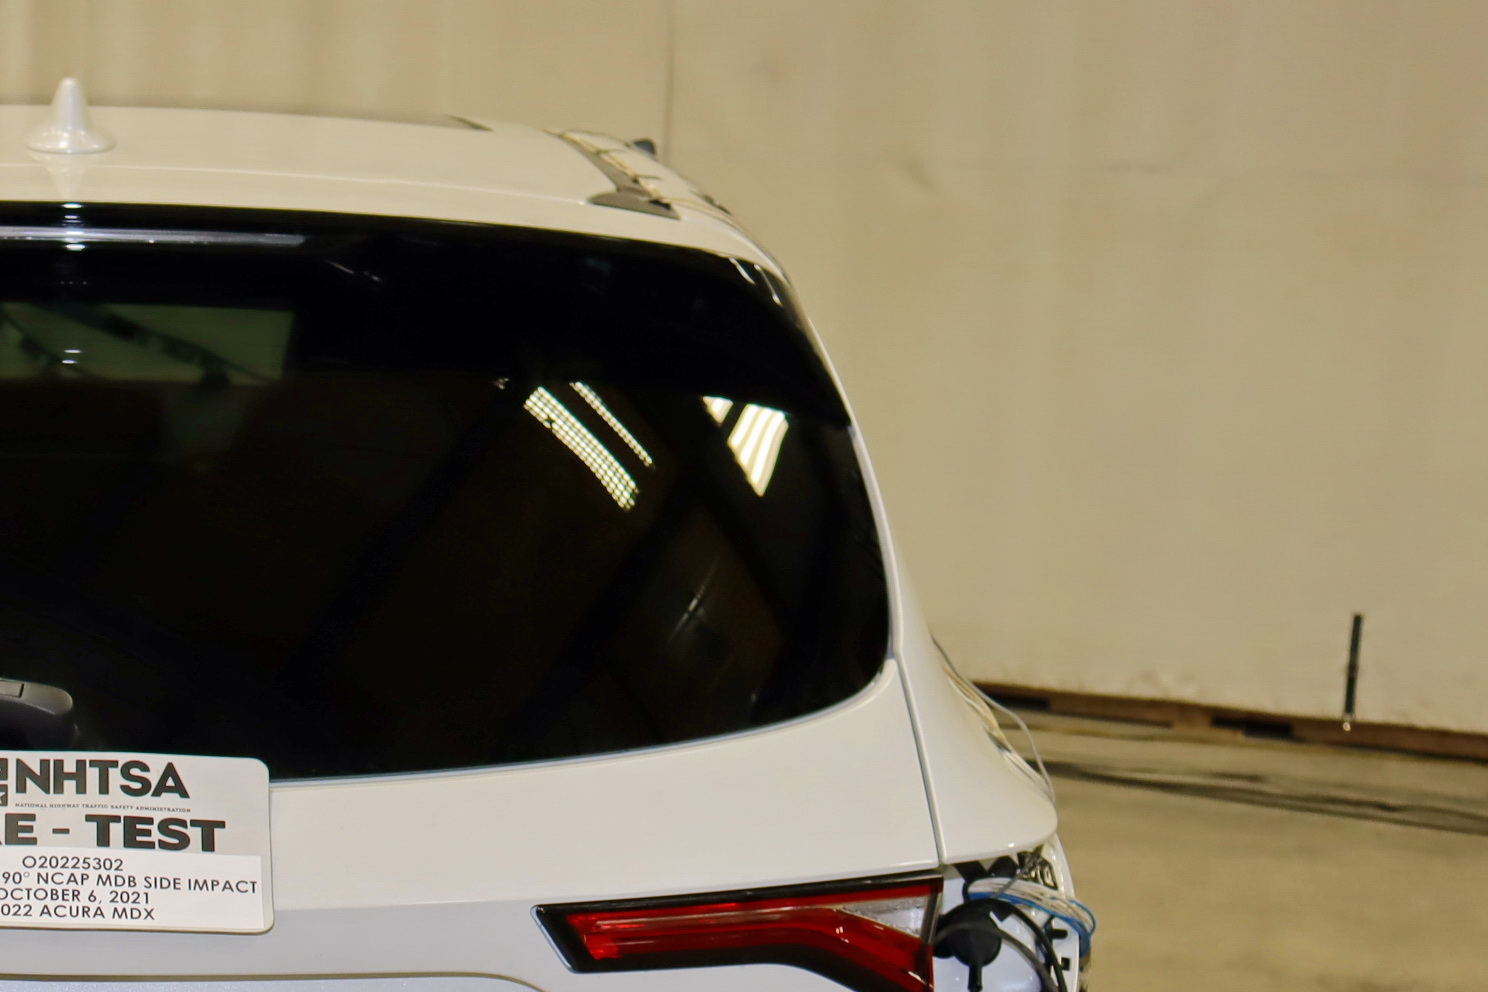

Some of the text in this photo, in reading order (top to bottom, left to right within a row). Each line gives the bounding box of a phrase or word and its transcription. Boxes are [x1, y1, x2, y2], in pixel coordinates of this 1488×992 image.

[15, 757, 190, 799] NHTSA
[85, 814, 226, 852] TEST
[1, 871, 31, 886] 90°
[37, 872, 90, 887] NCAP
[96, 873, 137, 889] MDB
[143, 876, 182, 891] SIDE
[188, 878, 258, 894] IMPACT
[87, 888, 103, 906] 6,
[109, 890, 151, 905] 2021
[39, 904, 105, 920] ACURA
[111, 906, 156, 921] MDX
